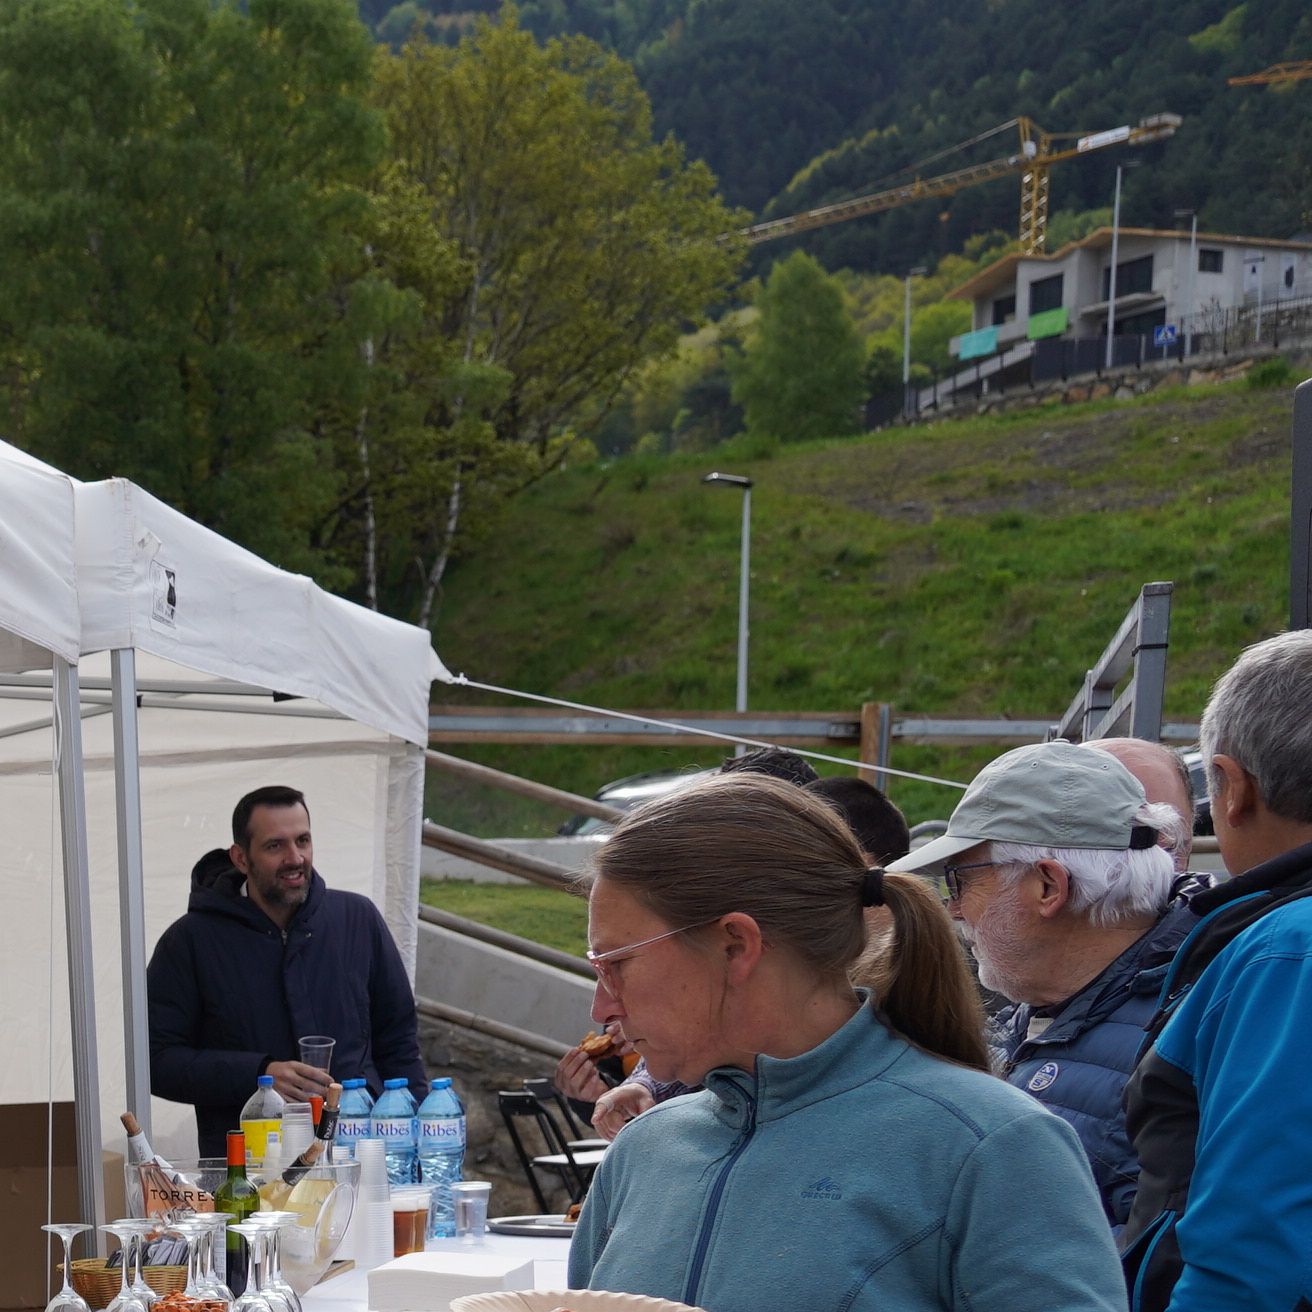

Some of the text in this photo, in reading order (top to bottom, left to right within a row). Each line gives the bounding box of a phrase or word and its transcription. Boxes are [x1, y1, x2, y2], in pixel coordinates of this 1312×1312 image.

[338, 1122, 370, 1136] Ribes
[376, 1122, 410, 1136] Ribes
[422, 1122, 457, 1137] Ribes
[150, 1189, 217, 1201] TORRES
